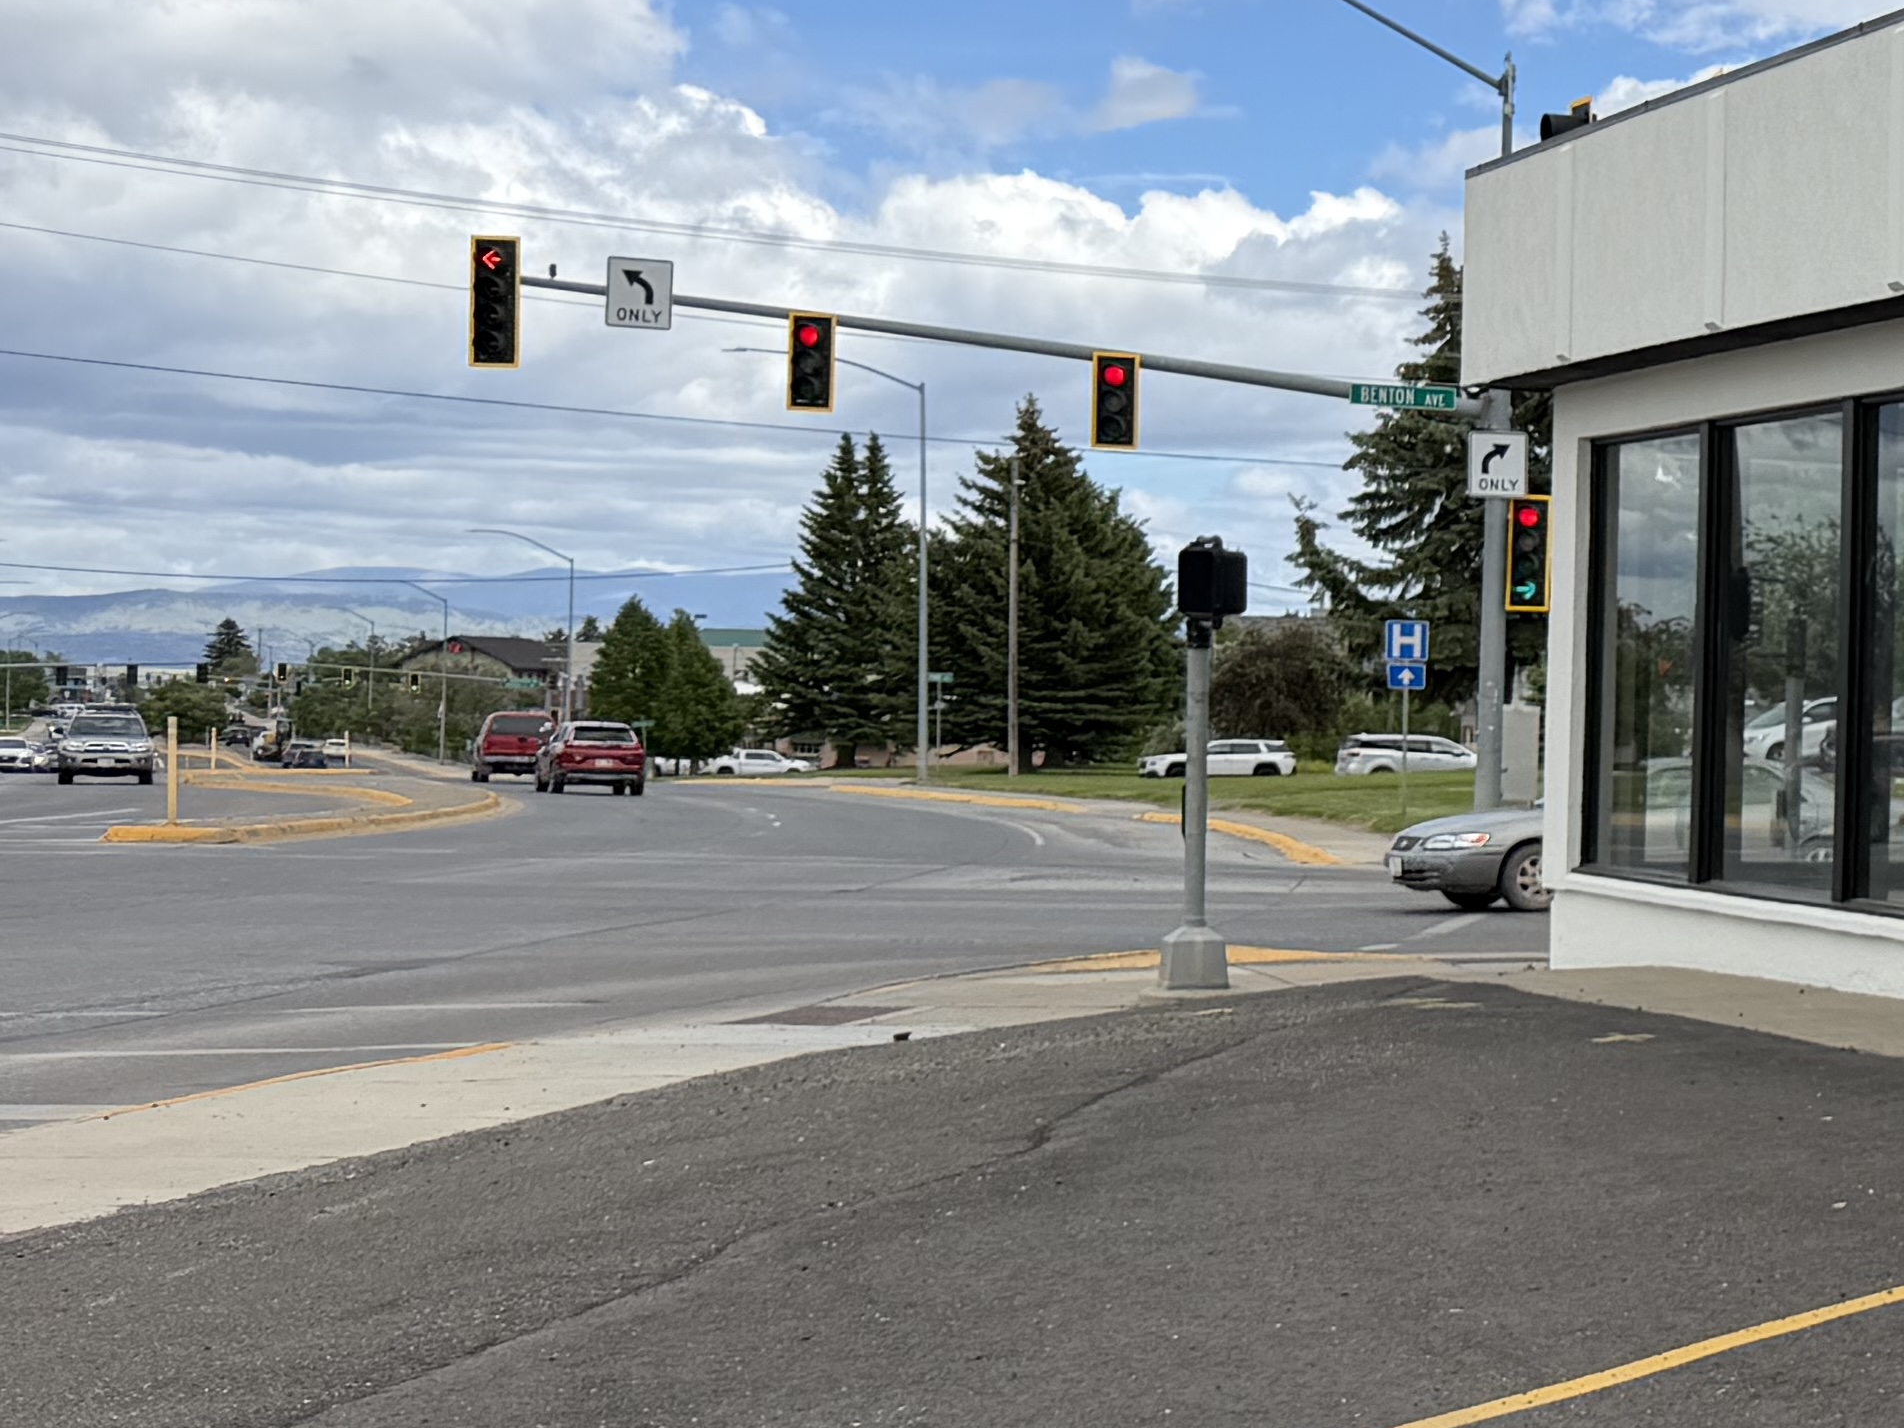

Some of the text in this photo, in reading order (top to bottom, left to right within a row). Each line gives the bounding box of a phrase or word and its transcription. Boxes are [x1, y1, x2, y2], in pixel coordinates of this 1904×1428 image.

[616, 307, 662, 324] ONLY
[1360, 386, 1445, 408] BENTON AVE
[1478, 477, 1519, 492] ONLY
[1392, 623, 1422, 659] H
